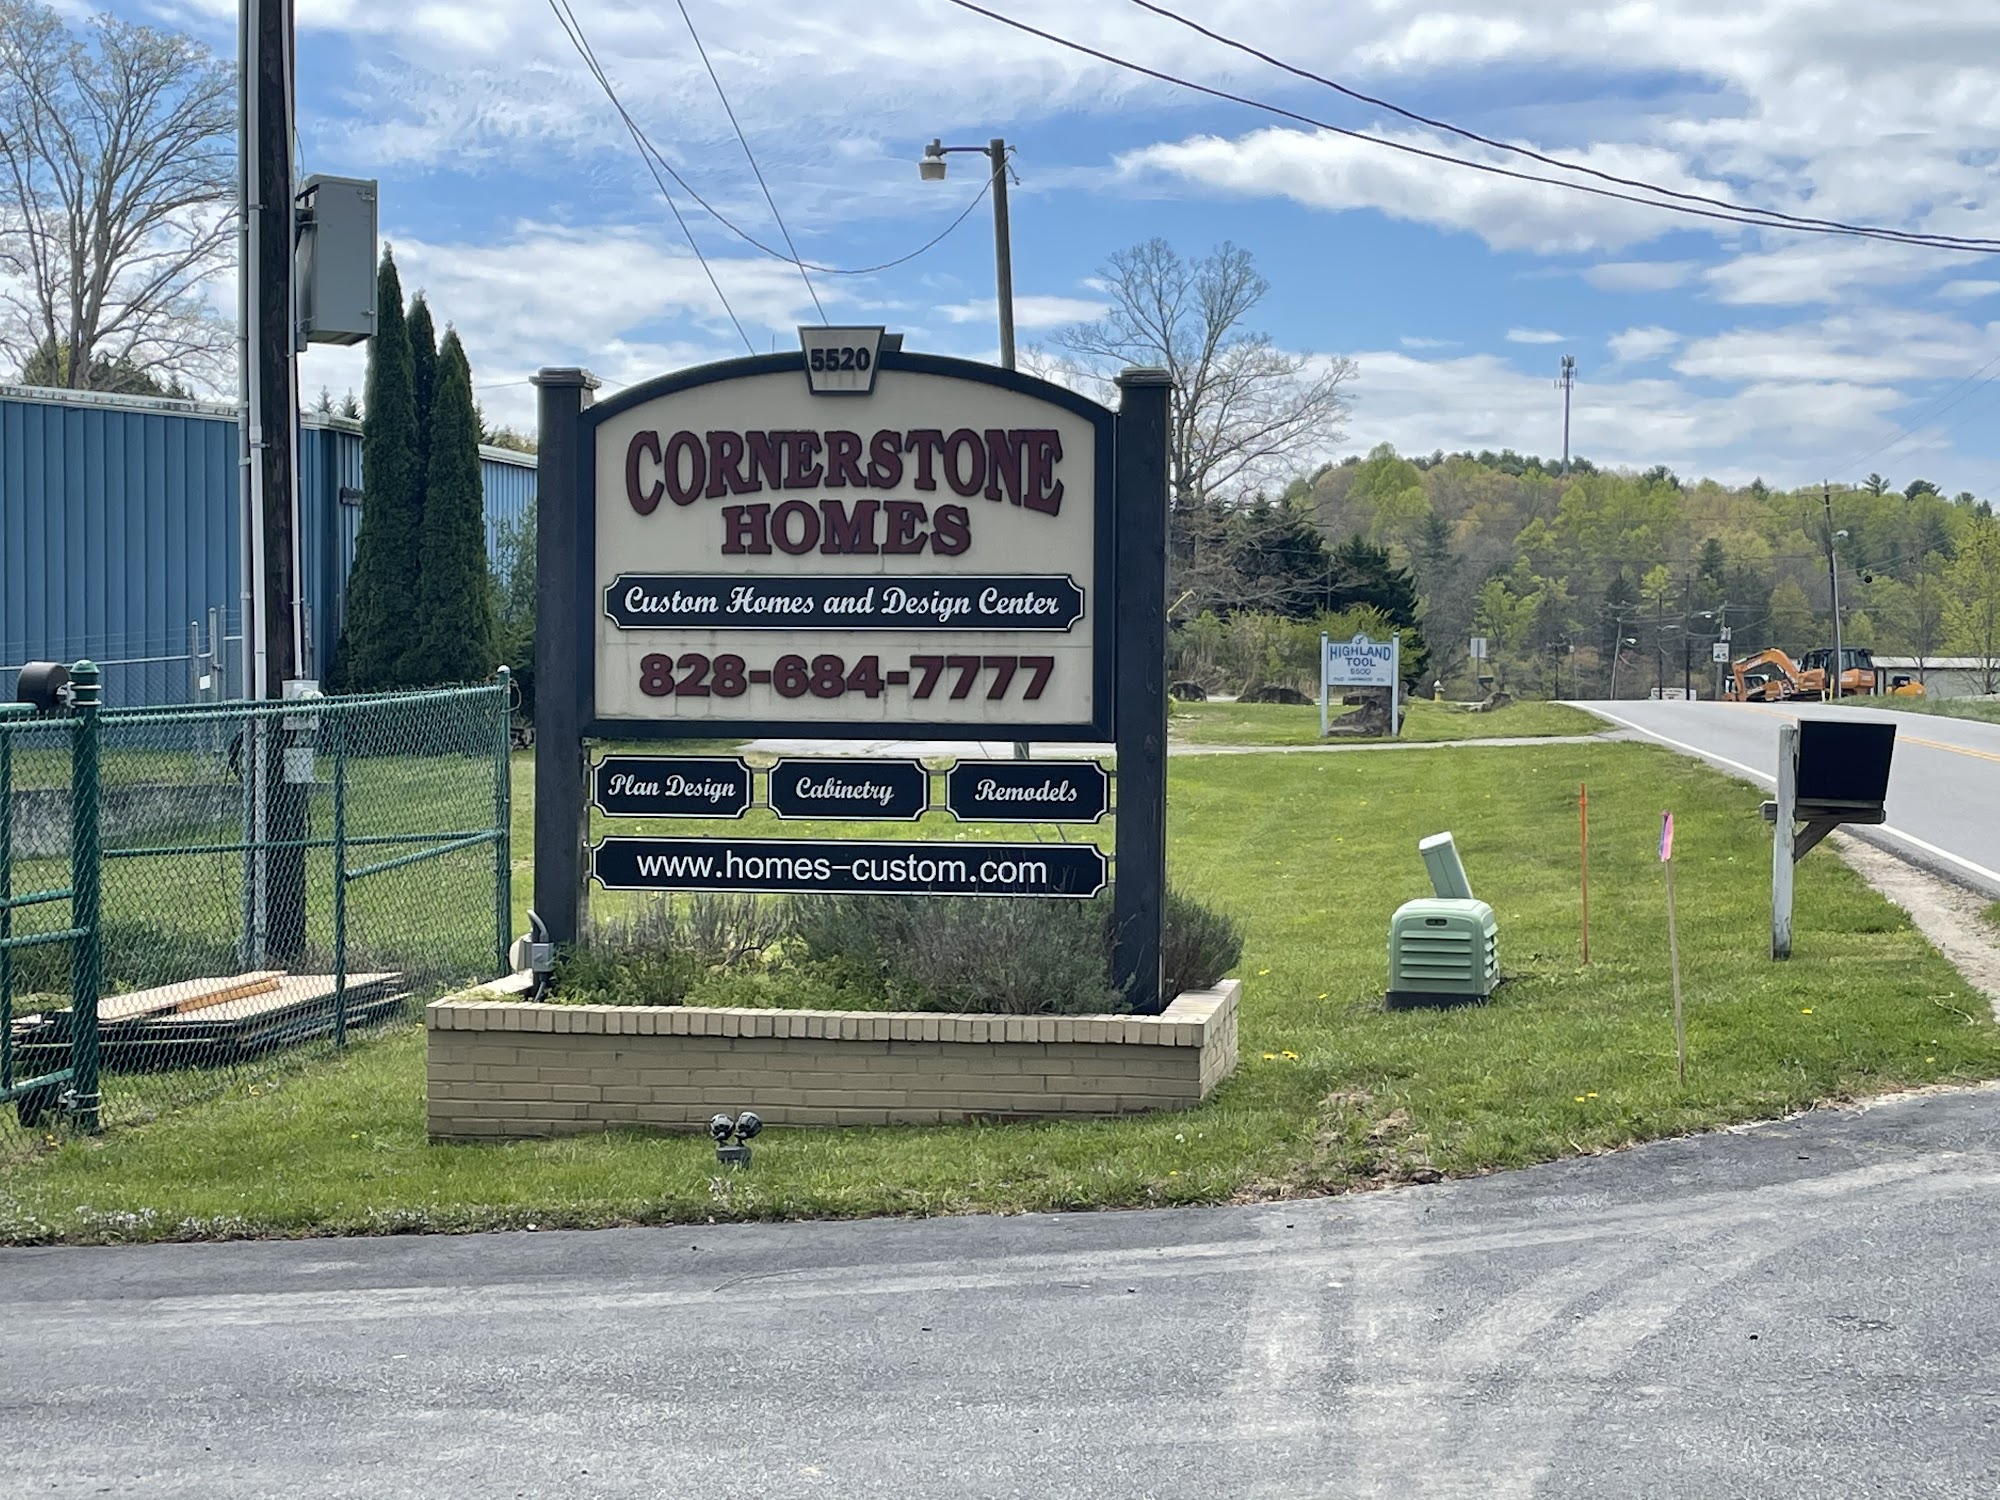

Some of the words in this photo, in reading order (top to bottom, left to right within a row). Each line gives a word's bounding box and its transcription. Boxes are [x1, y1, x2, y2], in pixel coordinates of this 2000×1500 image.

[810, 347, 871, 372] 5520
[625, 428, 1065, 517] CORNERSTONE
[721, 499, 972, 556] HOMES
[624, 586, 719, 614] Custom
[726, 586, 815, 614] Homes
[823, 587, 875, 615] and
[881, 587, 972, 622] Design
[979, 587, 1060, 615] Center
[1330, 646, 1391, 660] HIGHLAND
[1345, 658, 1376, 666] TOOL
[640, 653, 1055, 700] 828-684-7777
[608, 774, 661, 797] Plan
[665, 775, 736, 803] Design
[795, 776, 895, 806] Cabinetry
[974, 778, 1079, 802] Remodels
[637, 849, 1048, 884] www.homes-custom.com
